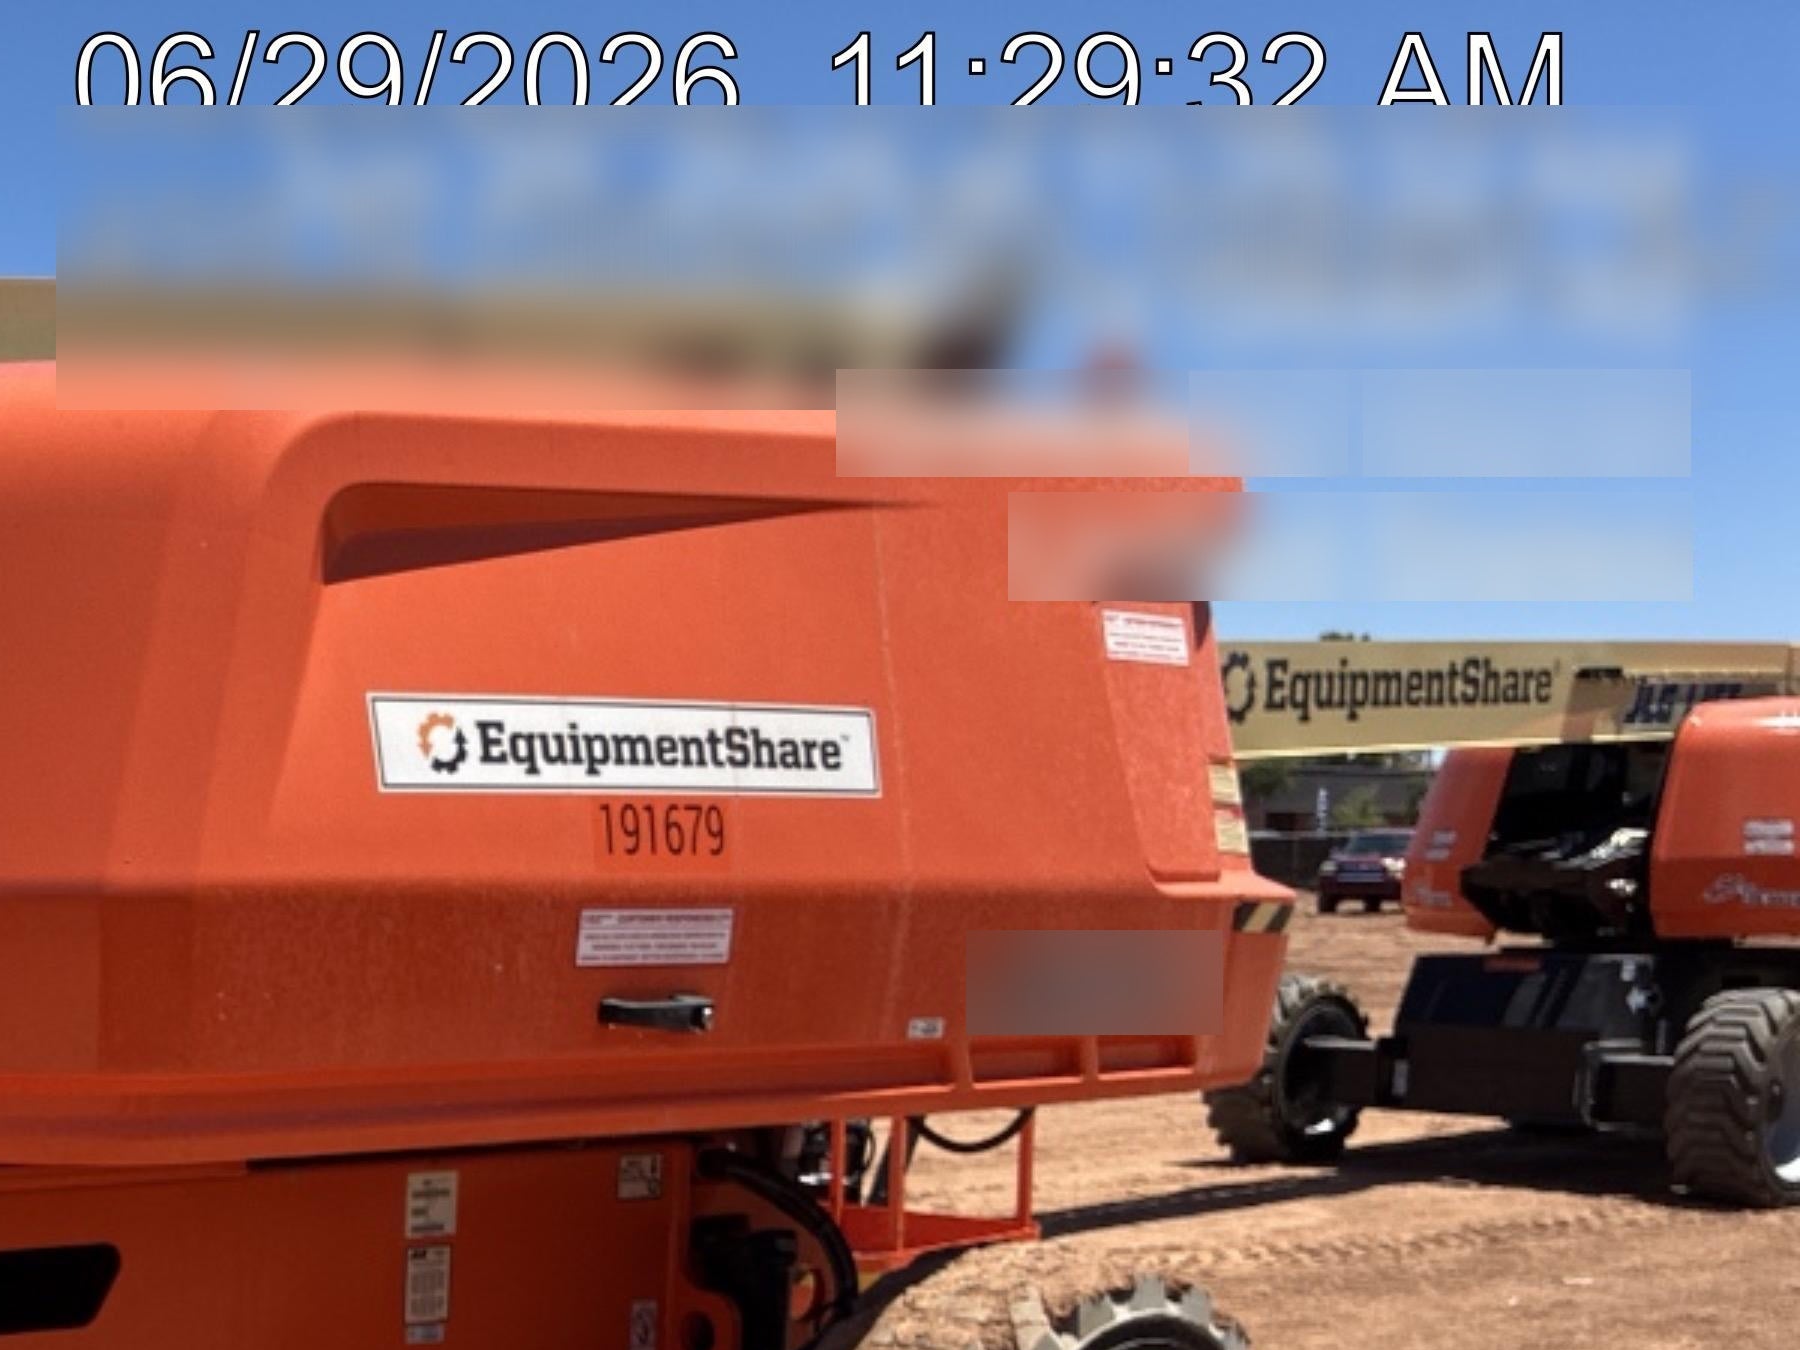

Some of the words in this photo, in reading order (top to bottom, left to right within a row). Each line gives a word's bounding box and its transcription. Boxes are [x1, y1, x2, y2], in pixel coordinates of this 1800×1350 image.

[1264, 656, 1554, 722] EquipmentShare
[476, 720, 842, 775] EquipmentShare
[599, 803, 725, 856] 191679
